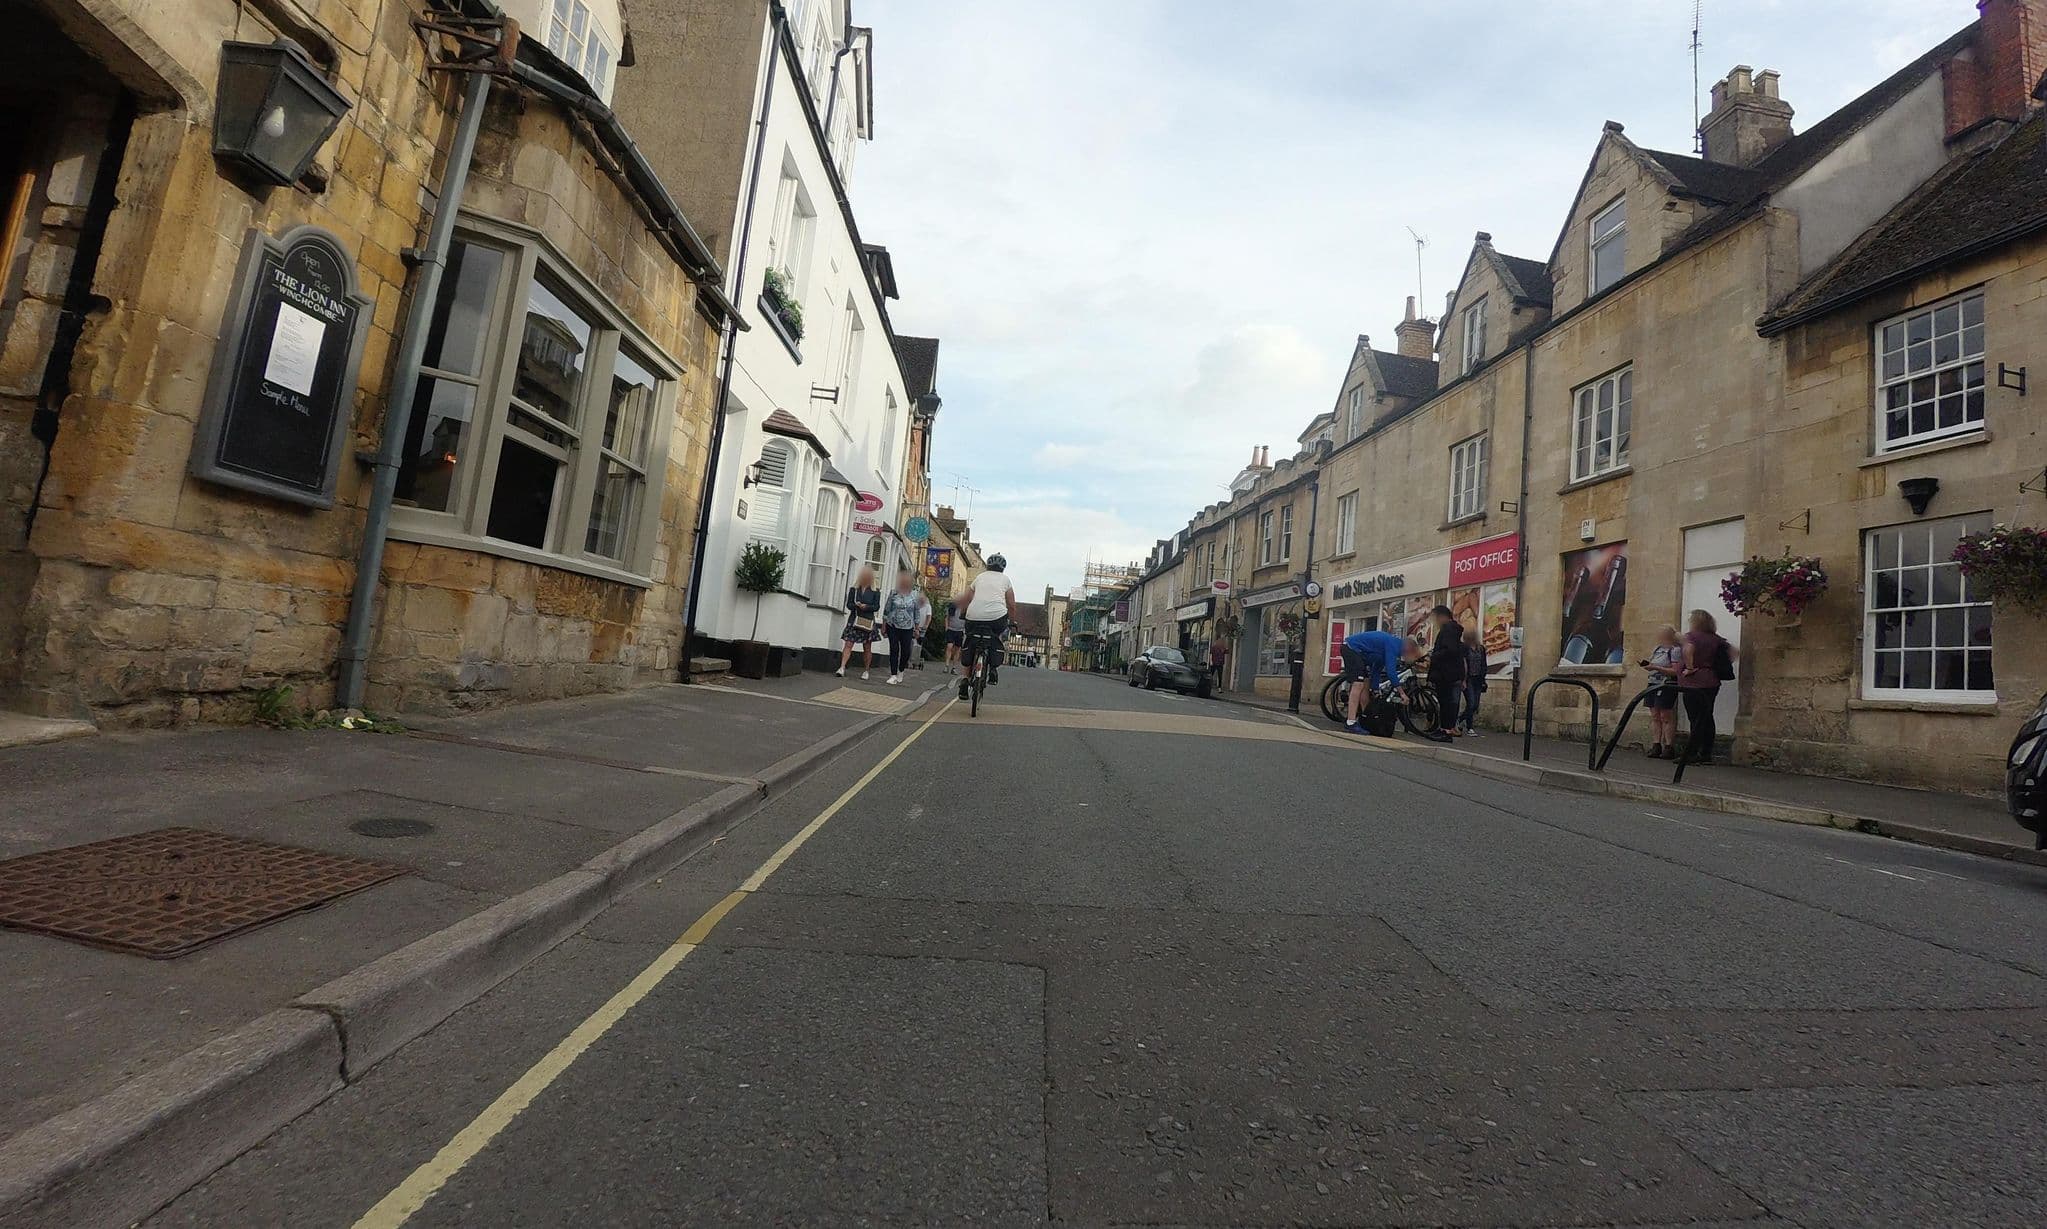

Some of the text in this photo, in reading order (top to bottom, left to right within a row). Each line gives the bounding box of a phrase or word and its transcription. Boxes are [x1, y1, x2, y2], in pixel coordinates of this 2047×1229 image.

[274, 269, 346, 317] THE LION INN
[260, 382, 288, 406] Sample
[1454, 548, 1514, 573] POST OFFICE
[1333, 582, 1352, 600] North
[1353, 577, 1376, 597] Street
[1377, 574, 1405, 592] Stores
